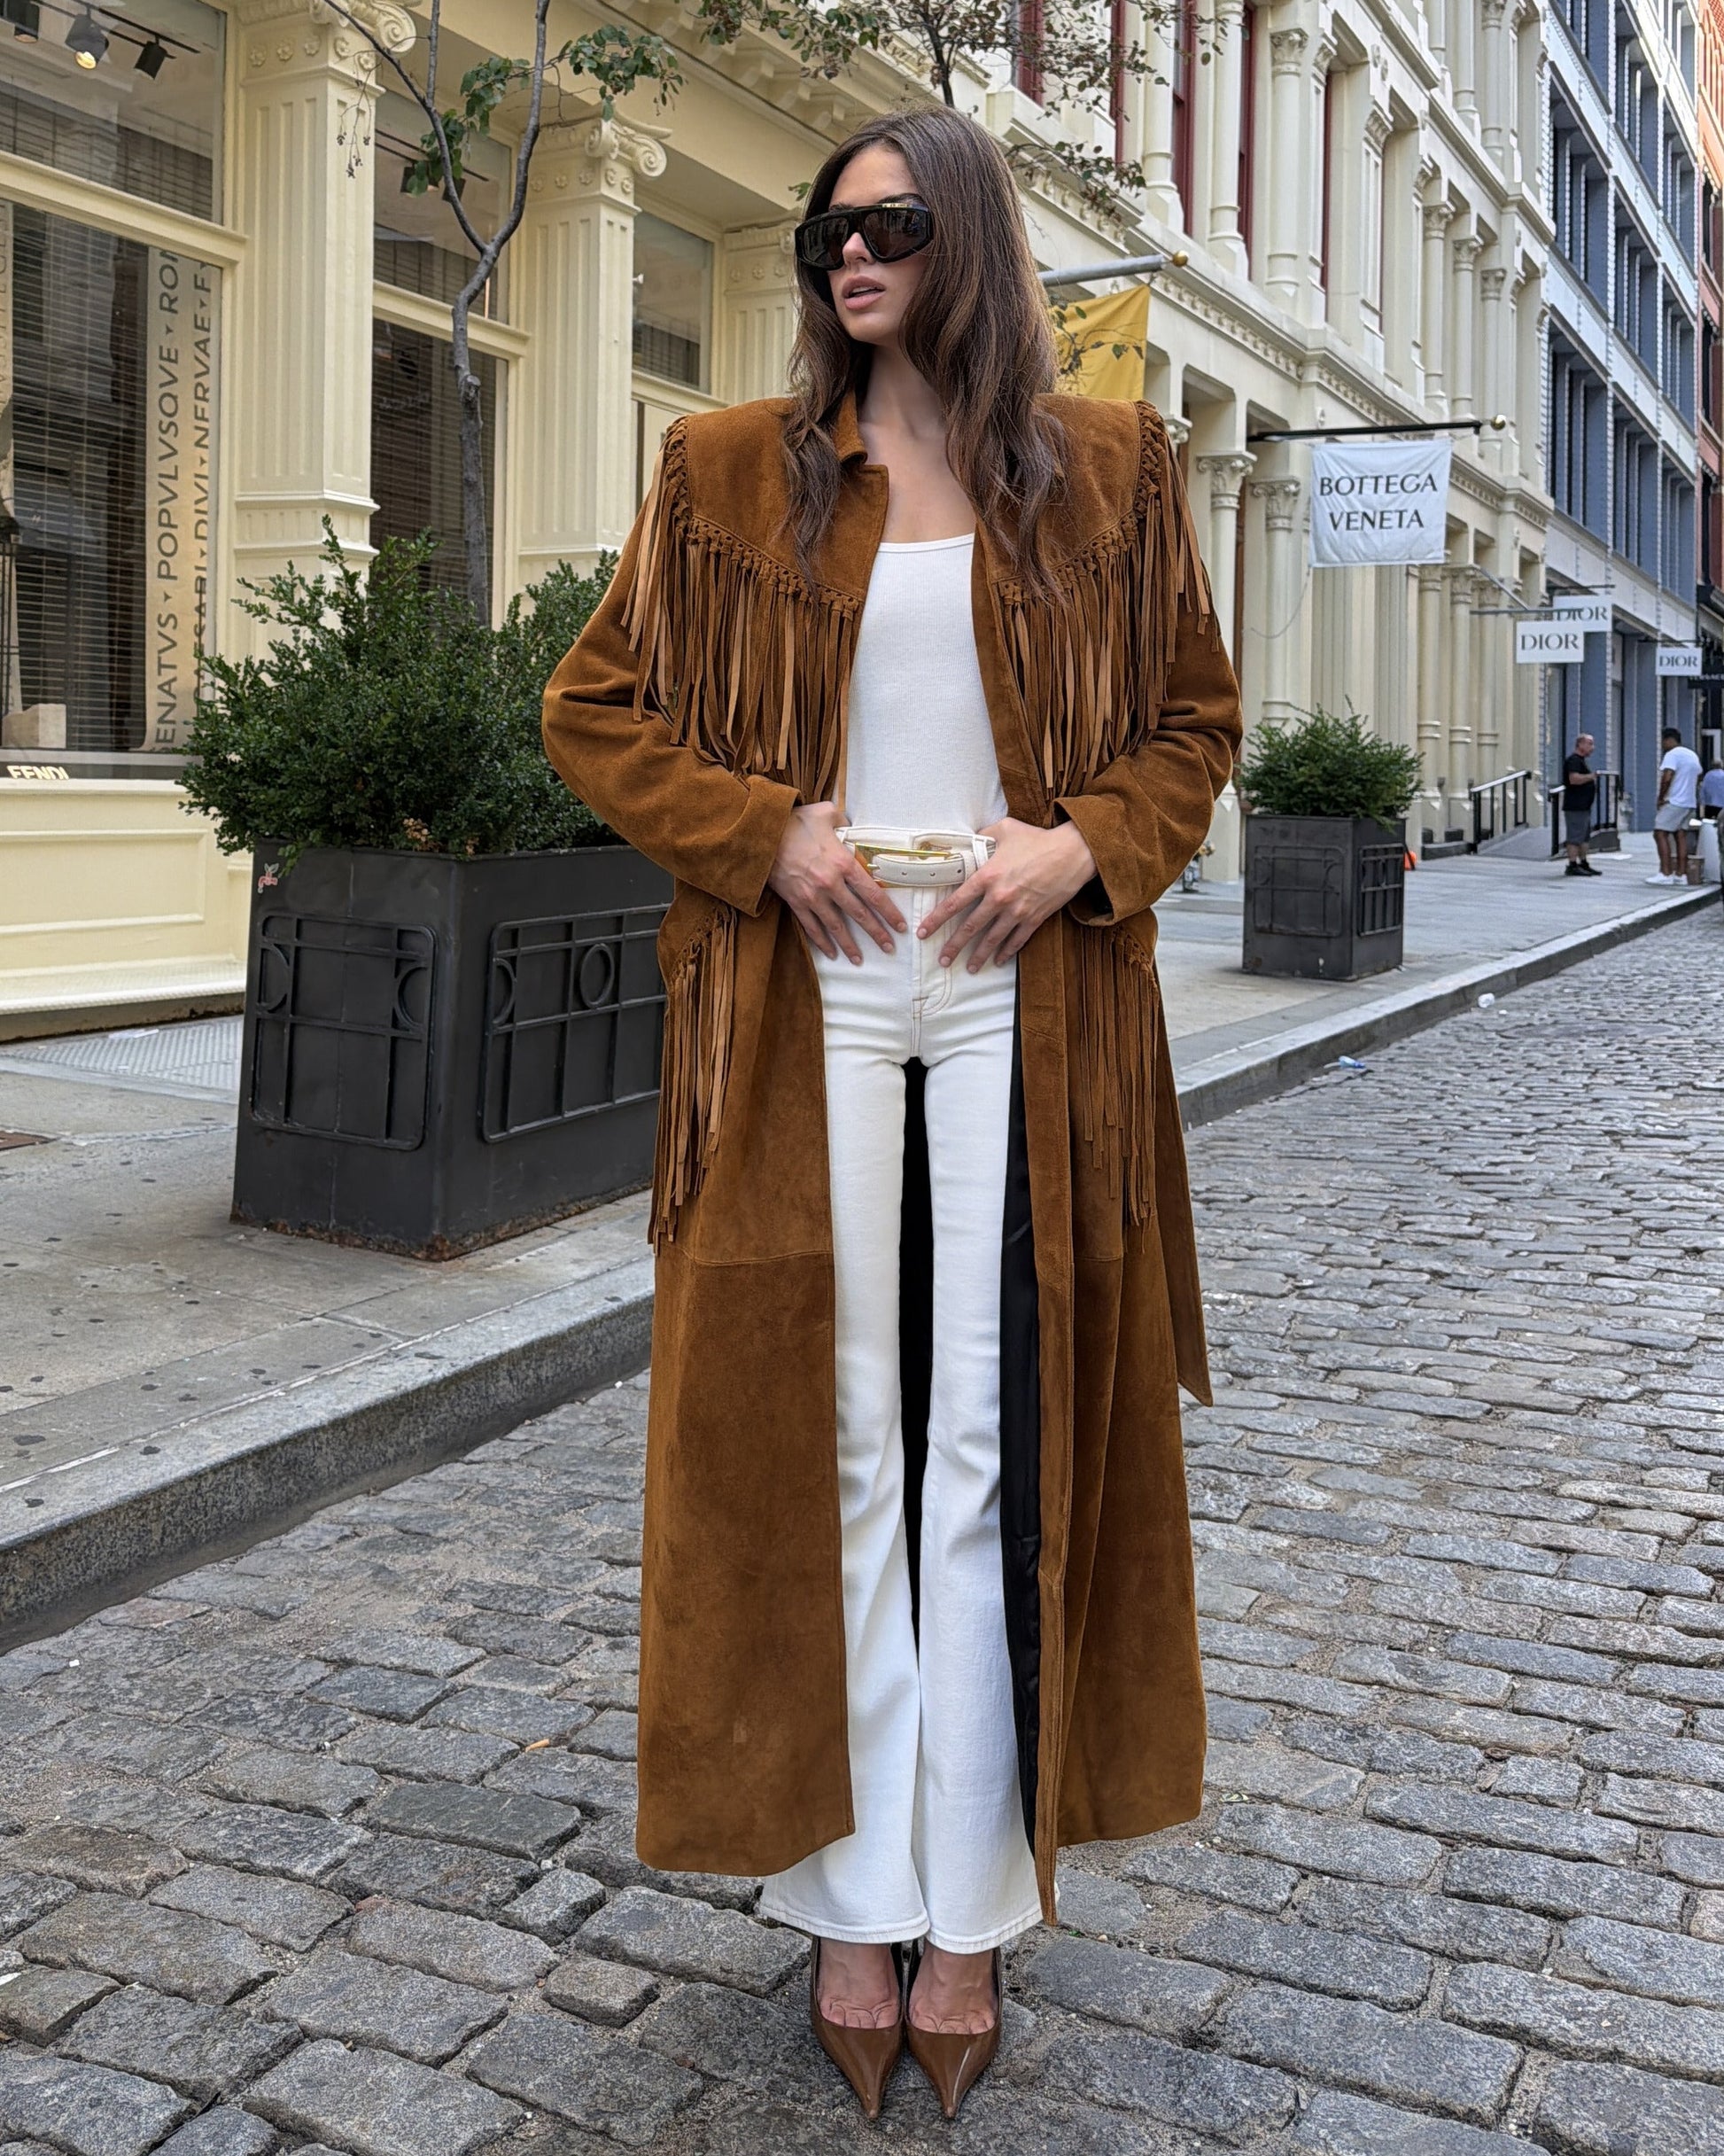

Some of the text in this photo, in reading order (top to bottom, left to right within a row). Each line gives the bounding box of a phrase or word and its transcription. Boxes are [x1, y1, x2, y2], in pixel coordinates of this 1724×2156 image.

[1320, 473, 1438, 496] BOTTEGA
[1330, 510, 1425, 532] VENETA
[1557, 606, 1608, 621] DIOR
[1521, 633, 1579, 650] DIOR
[1659, 656, 1697, 667] DIOR
